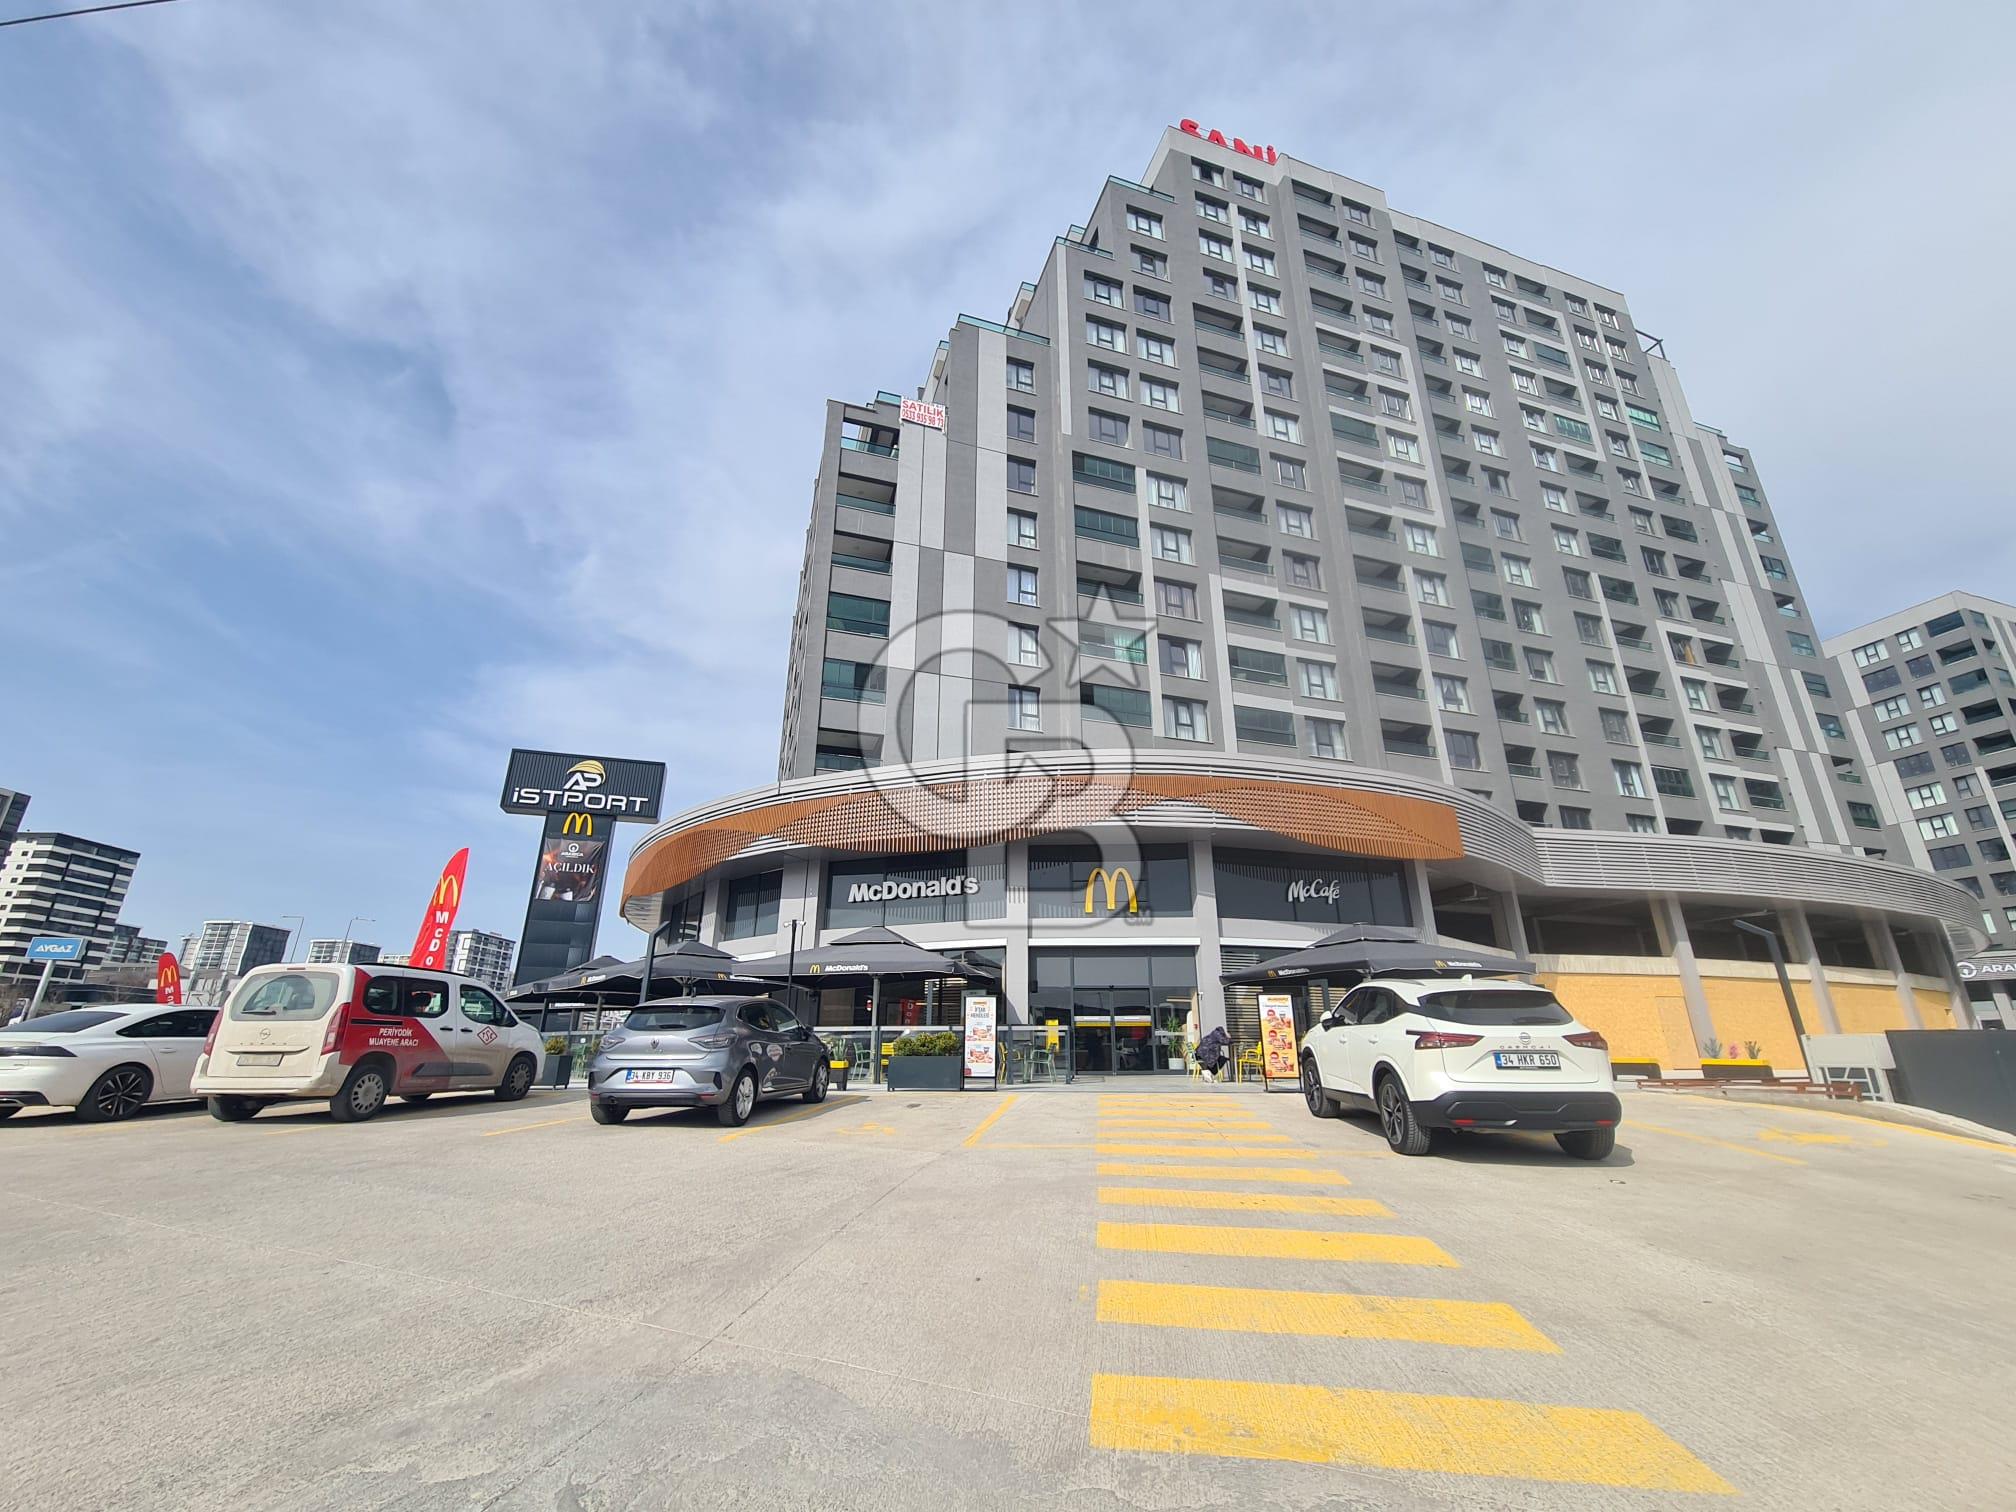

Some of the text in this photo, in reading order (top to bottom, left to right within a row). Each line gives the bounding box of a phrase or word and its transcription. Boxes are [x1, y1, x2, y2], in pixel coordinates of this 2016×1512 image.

[902, 400, 944, 417] SATILIK
[847, 875, 979, 903] McDonald's
[1287, 878, 1340, 905] McCafé
[35, 944, 74, 953] AYGAZ
[369, 1037, 400, 1046] MUAYENE
[1501, 1055, 1557, 1065] 34 HKR 650
[658, 1072, 672, 1080] 936
